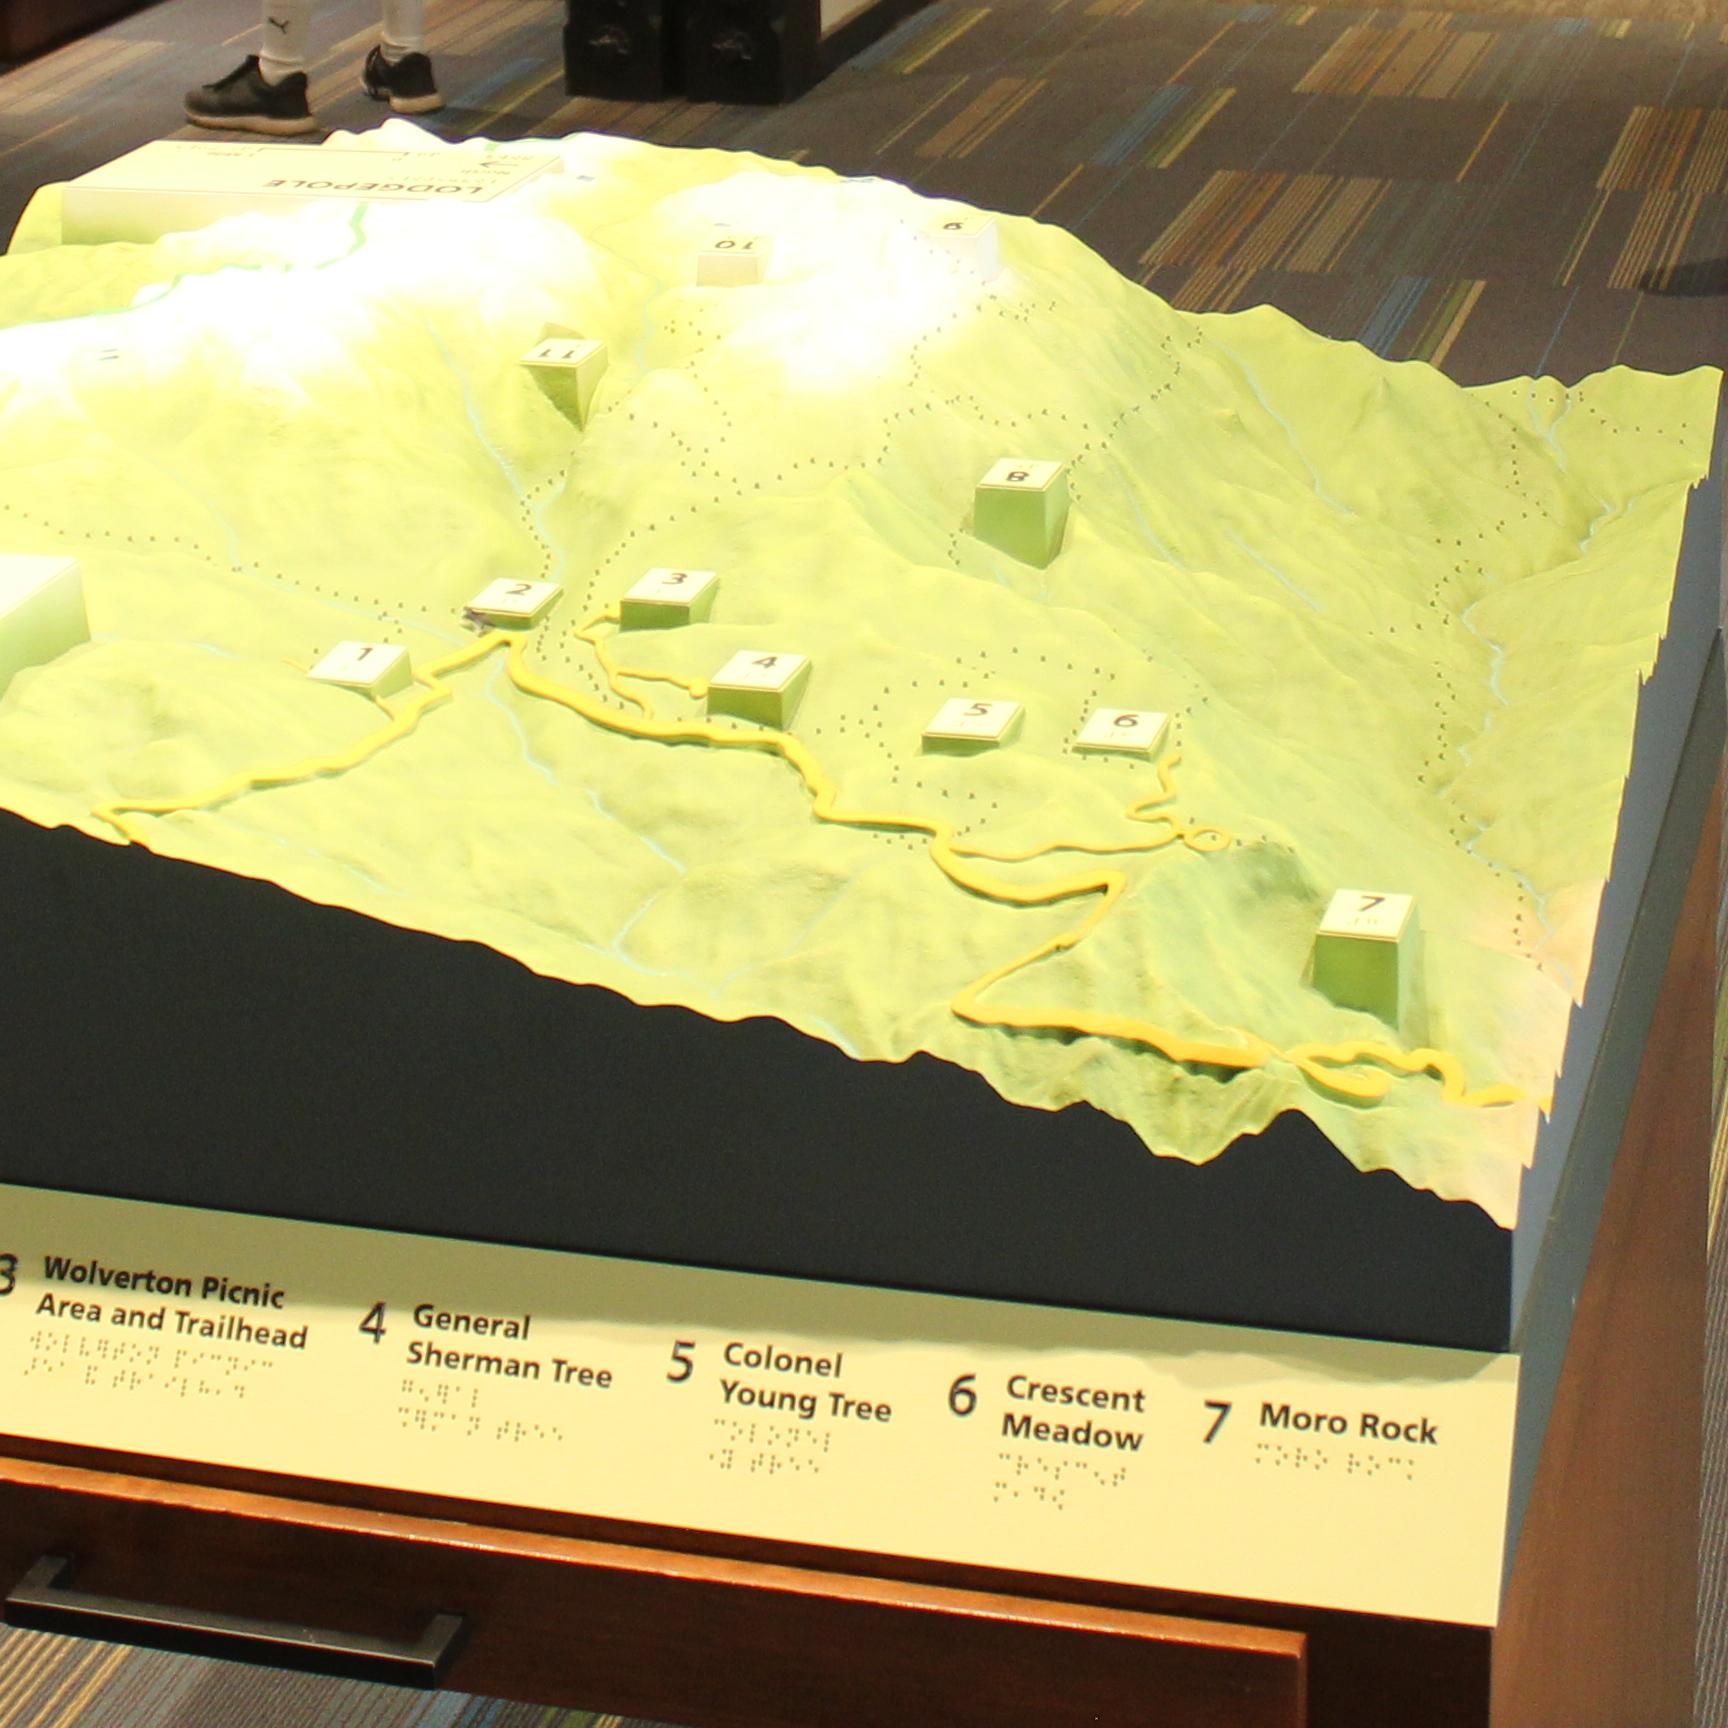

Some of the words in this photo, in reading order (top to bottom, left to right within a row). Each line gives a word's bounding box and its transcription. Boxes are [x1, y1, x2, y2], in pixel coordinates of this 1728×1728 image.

[506, 583, 534, 597] 2
[668, 573, 690, 585] 3
[356, 646, 374, 661] 1
[752, 655, 780, 670] 4
[963, 702, 991, 718] 5
[1113, 713, 1141, 729] 6
[1357, 896, 1388, 914] 7
[43, 1254, 194, 1301] Wolverton
[202, 1269, 287, 1312] Picnic
[35, 1291, 100, 1327] Area
[110, 1297, 165, 1332] and
[172, 1306, 309, 1352] Trailhead
[357, 1300, 387, 1344] 4
[412, 1302, 532, 1344] General
[406, 1340, 542, 1385] Sherman
[549, 1358, 614, 1390] Tree
[666, 1340, 696, 1385] 5
[722, 1341, 843, 1382] Colonel
[719, 1377, 818, 1427] Young
[827, 1392, 893, 1425] Tree
[947, 1373, 979, 1417] 6
[1005, 1374, 1146, 1415] Crescent
[1000, 1411, 1144, 1453] Meadow
[1203, 1400, 1233, 1445] 7
[1259, 1401, 1353, 1441] Moro
[1359, 1412, 1439, 1448] Rock
